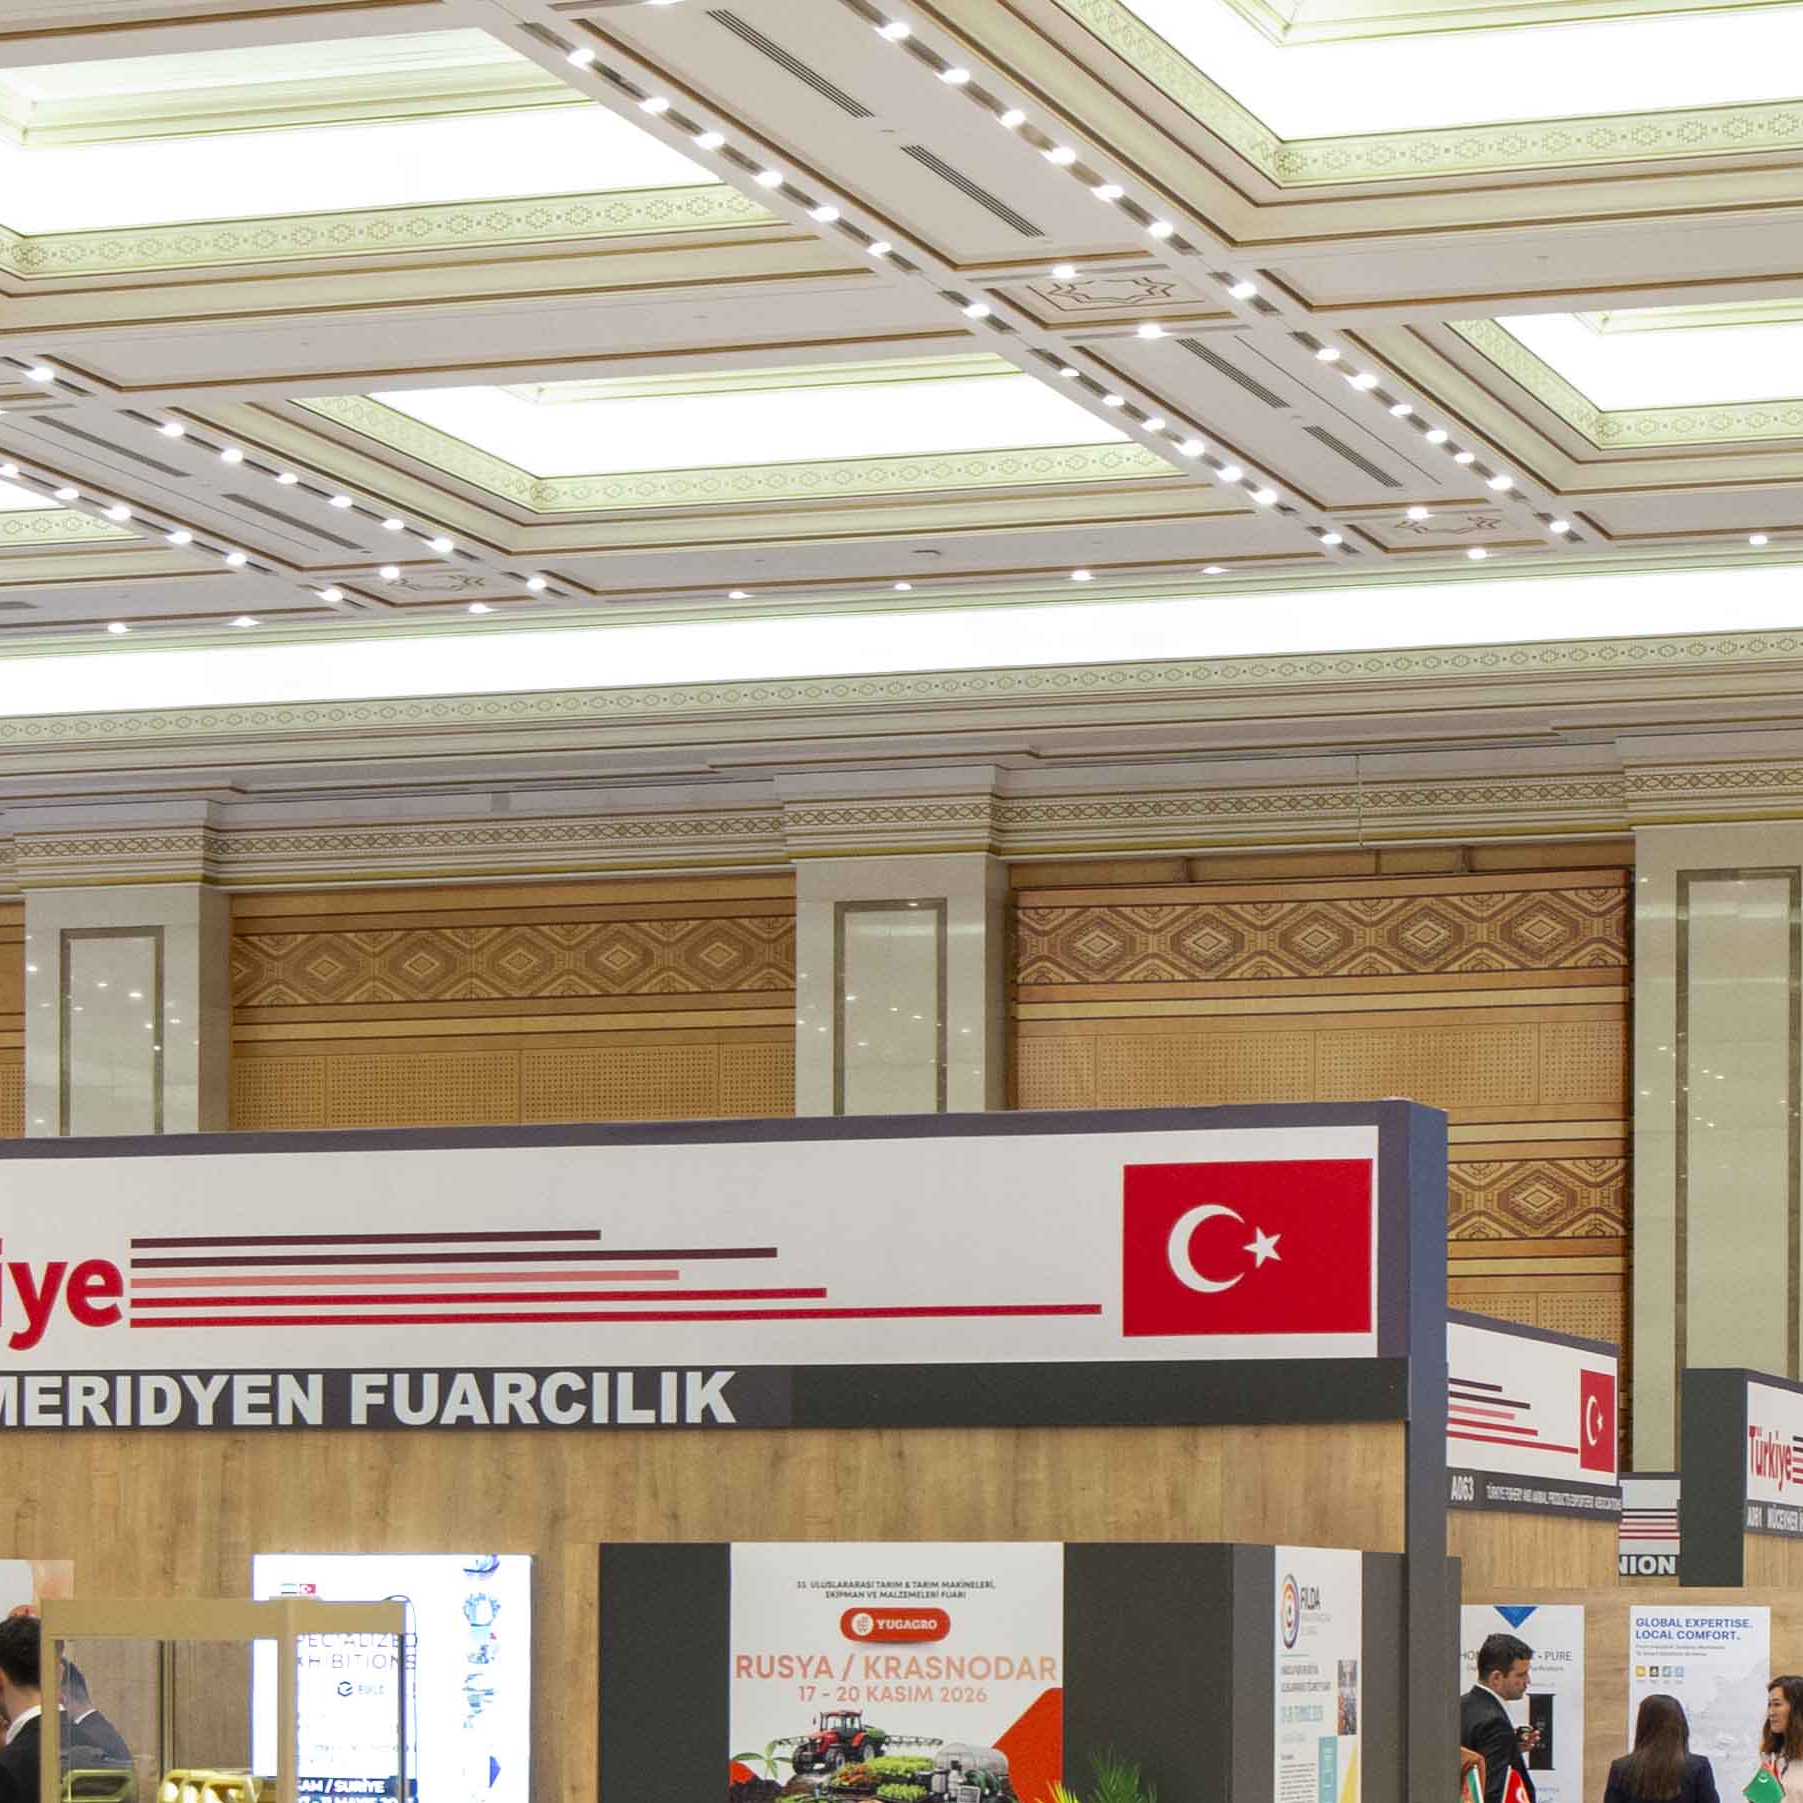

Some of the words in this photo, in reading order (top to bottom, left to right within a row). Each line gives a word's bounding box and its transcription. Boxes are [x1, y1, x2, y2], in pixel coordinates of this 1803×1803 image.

[350, 1370, 738, 1427] FUARCILIK
[1749, 1424, 1792, 1492] Türkiye
[876, 1619, 938, 1631] YUGAGRO
[1635, 1618, 1683, 1628] GLOBAL
[1635, 1630, 1674, 1640] LOCAL
[734, 1653, 835, 1681] RUSYA
[841, 1652, 856, 1682] /
[863, 1654, 1057, 1682] KRASNODAR
[799, 1686, 816, 1702] 17
[836, 1686, 860, 1702] 20
[866, 1686, 934, 1702] KASIM
[939, 1686, 988, 1703] 2026
